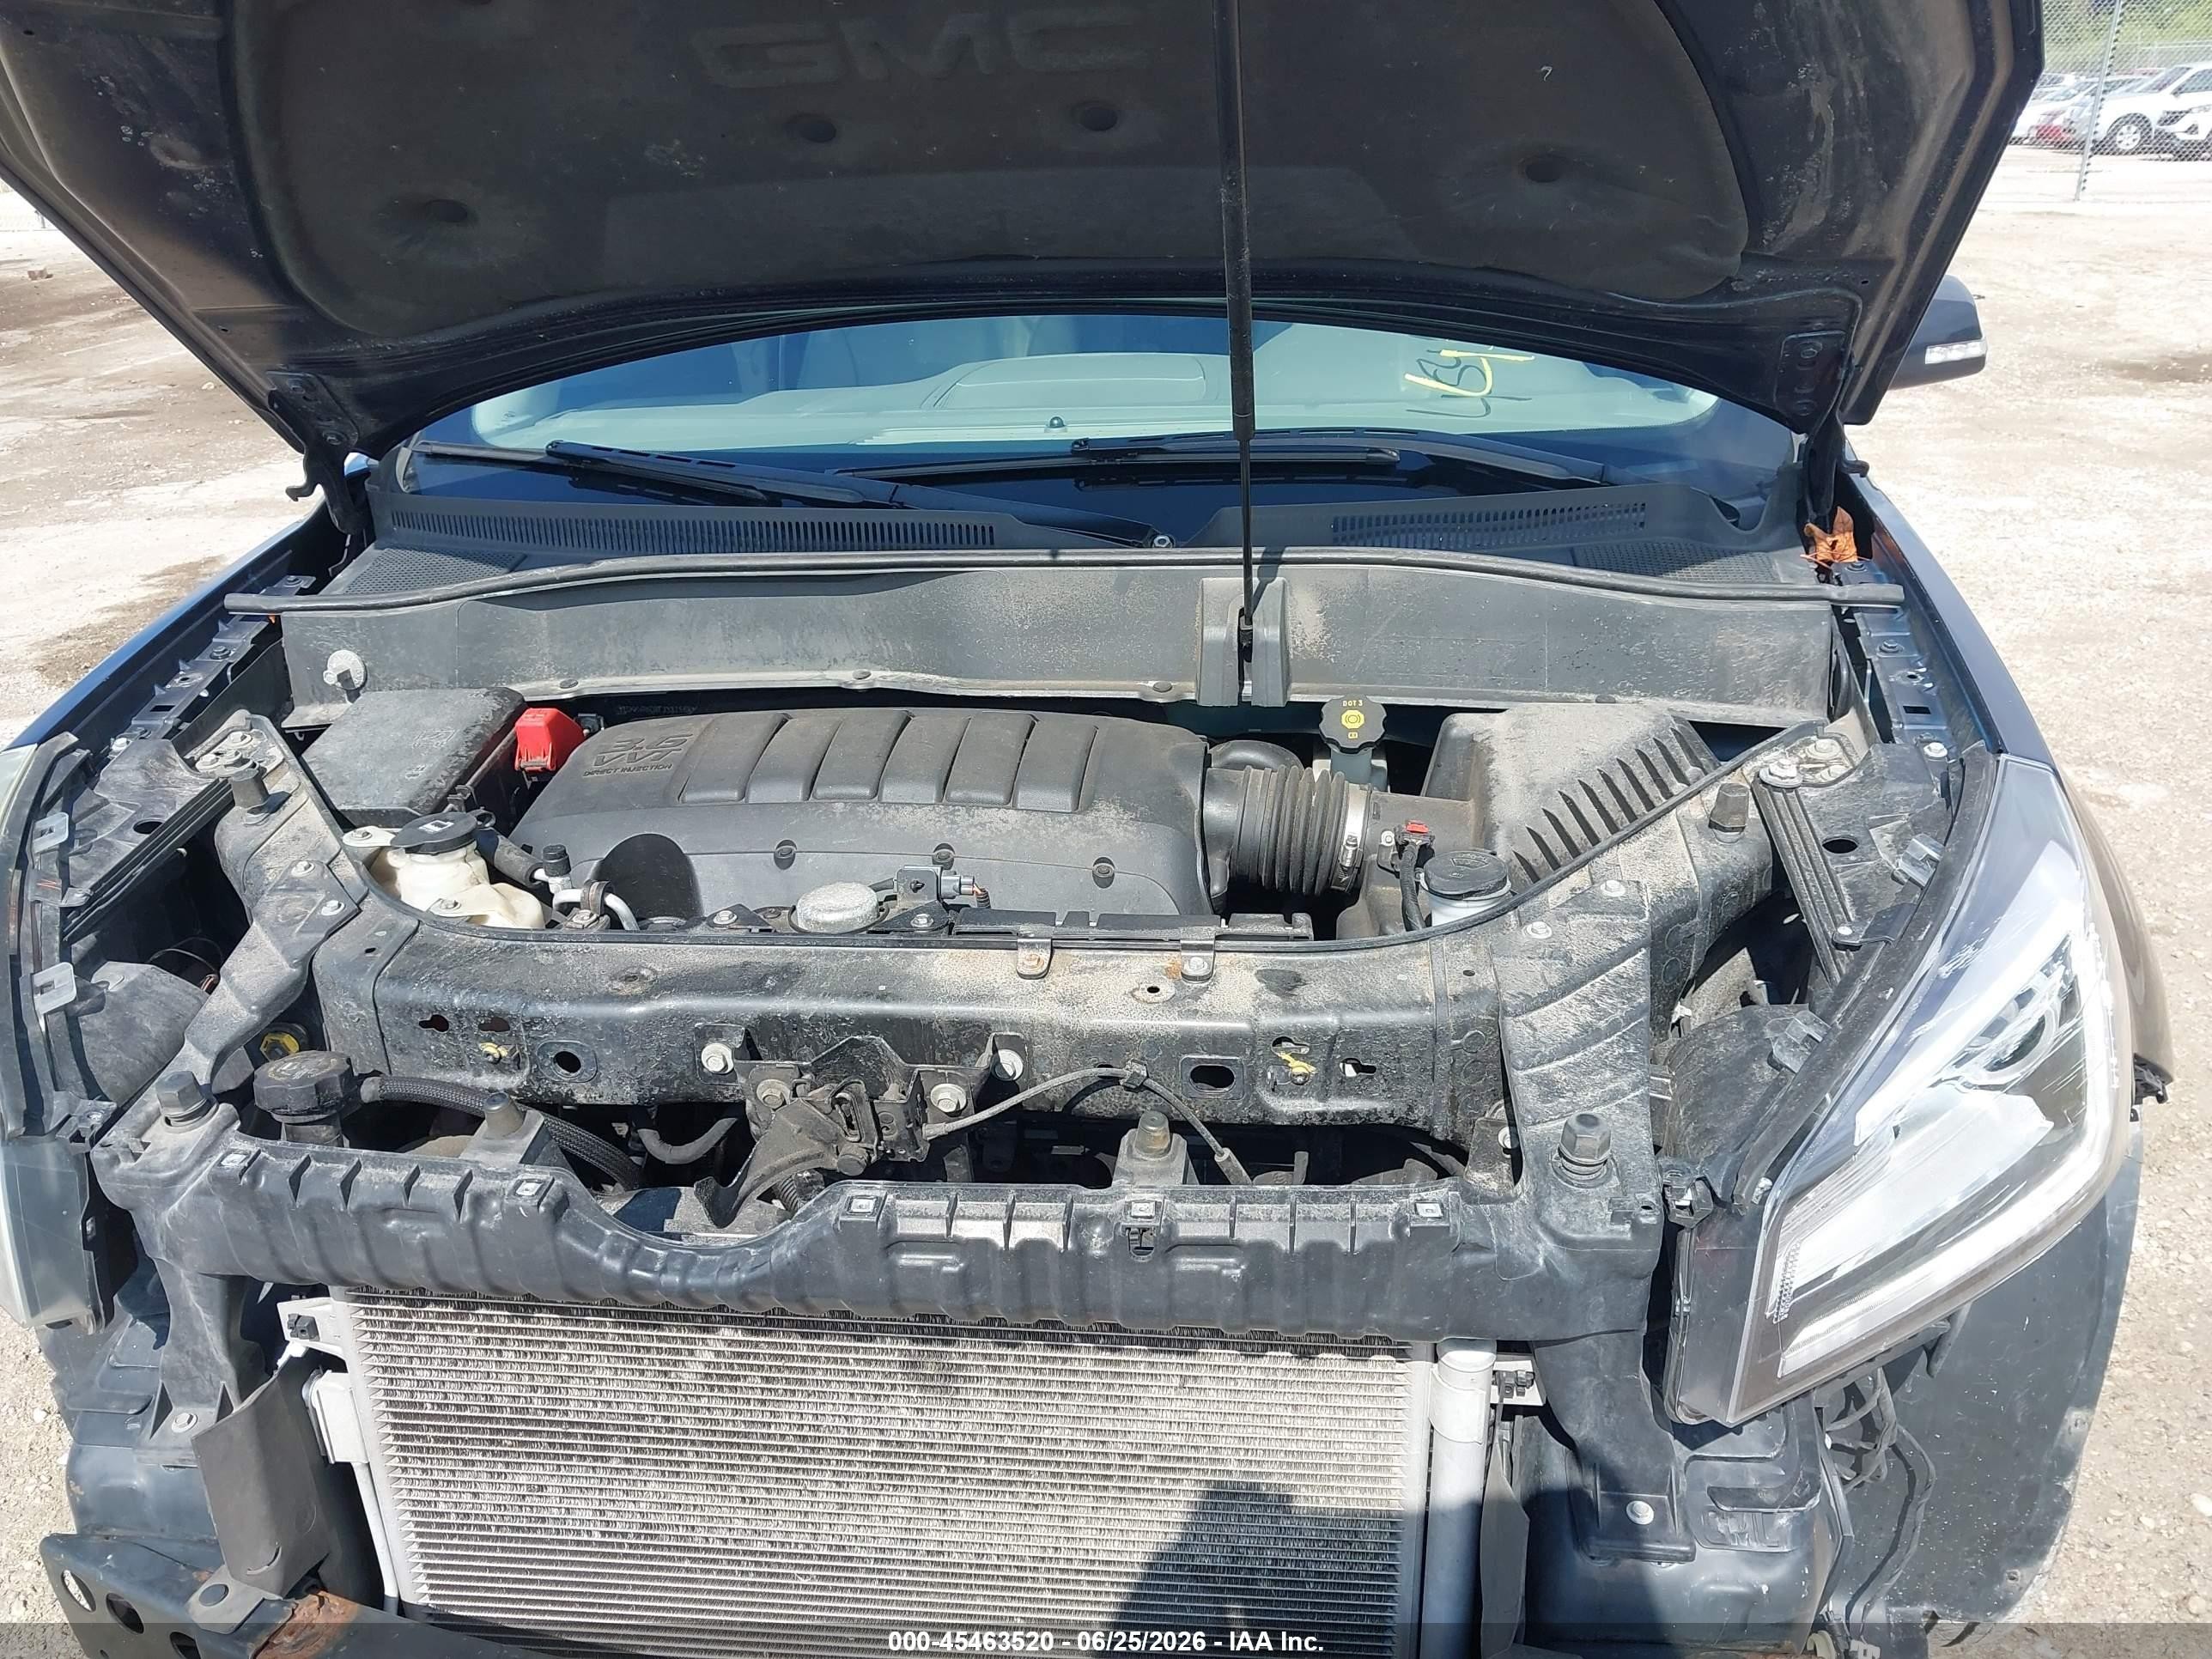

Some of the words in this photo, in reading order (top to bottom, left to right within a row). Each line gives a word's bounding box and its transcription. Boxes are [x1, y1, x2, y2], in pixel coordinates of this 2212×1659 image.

[687, 5, 1152, 88] GMC
[601, 734, 694, 753] 3.6
[593, 748, 682, 767] VVT
[584, 767, 617, 777] DIRECT
[620, 763, 672, 774] INJECTION
